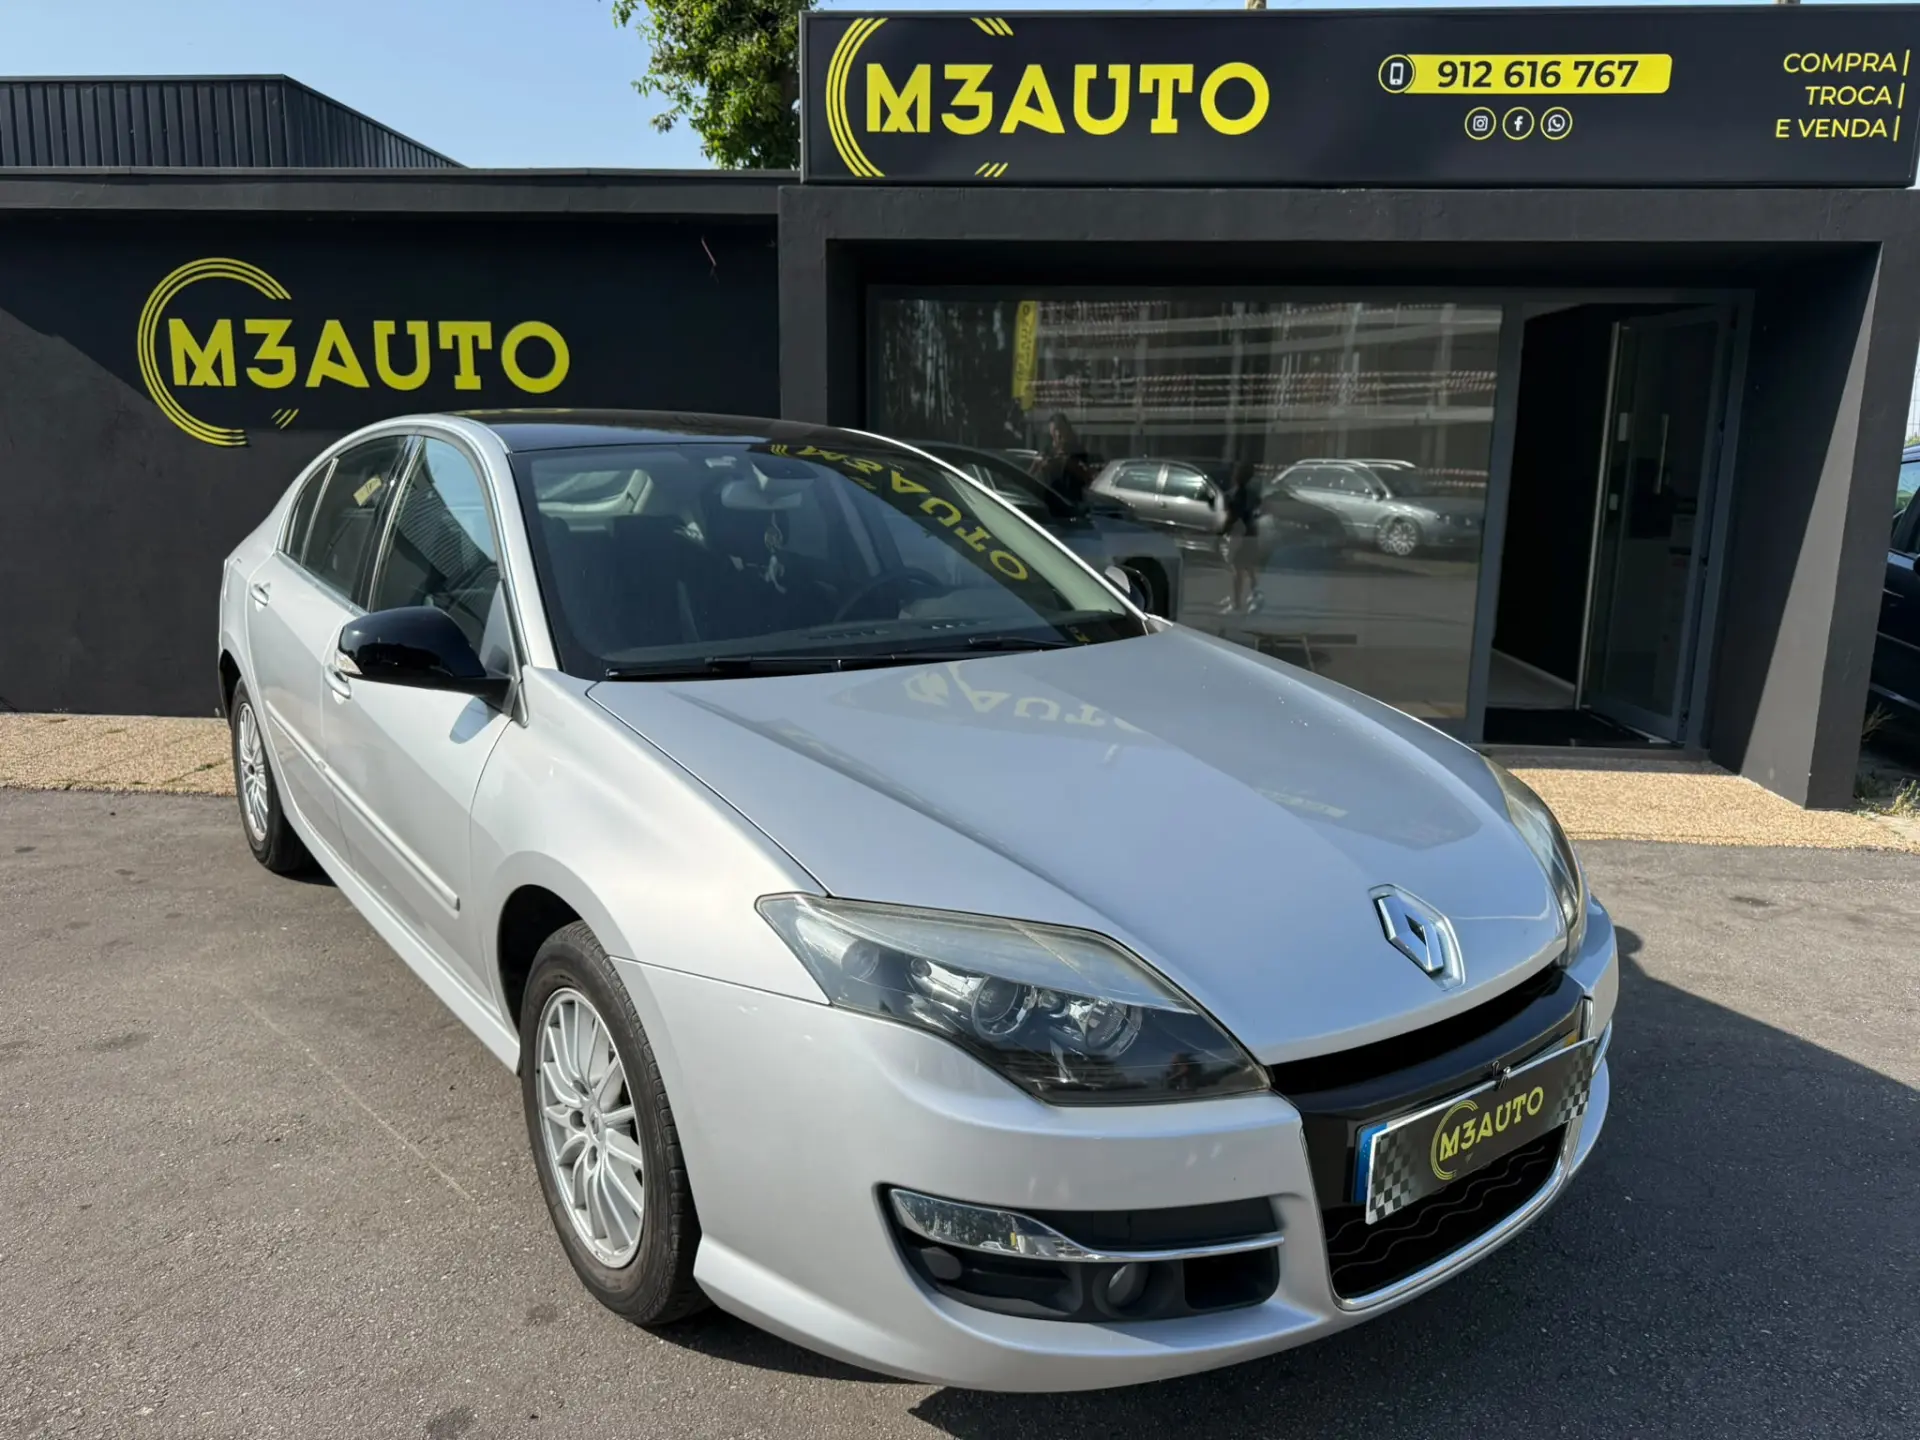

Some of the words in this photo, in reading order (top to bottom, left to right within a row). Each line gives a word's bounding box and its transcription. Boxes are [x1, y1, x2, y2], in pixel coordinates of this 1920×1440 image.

[1437, 60, 1493, 88] 912
[1503, 60, 1562, 89] 616
[1573, 60, 1640, 88] 767
[1783, 52, 1898, 73] COMPRA
[866, 61, 1270, 136] M3AUTO
[1804, 85, 1893, 106] TROCA
[1775, 118, 1792, 138] E
[1798, 118, 1888, 138] VENDA
[168, 318, 571, 394] M3AUTO
[1438, 1086, 1545, 1163] M3AUTO
